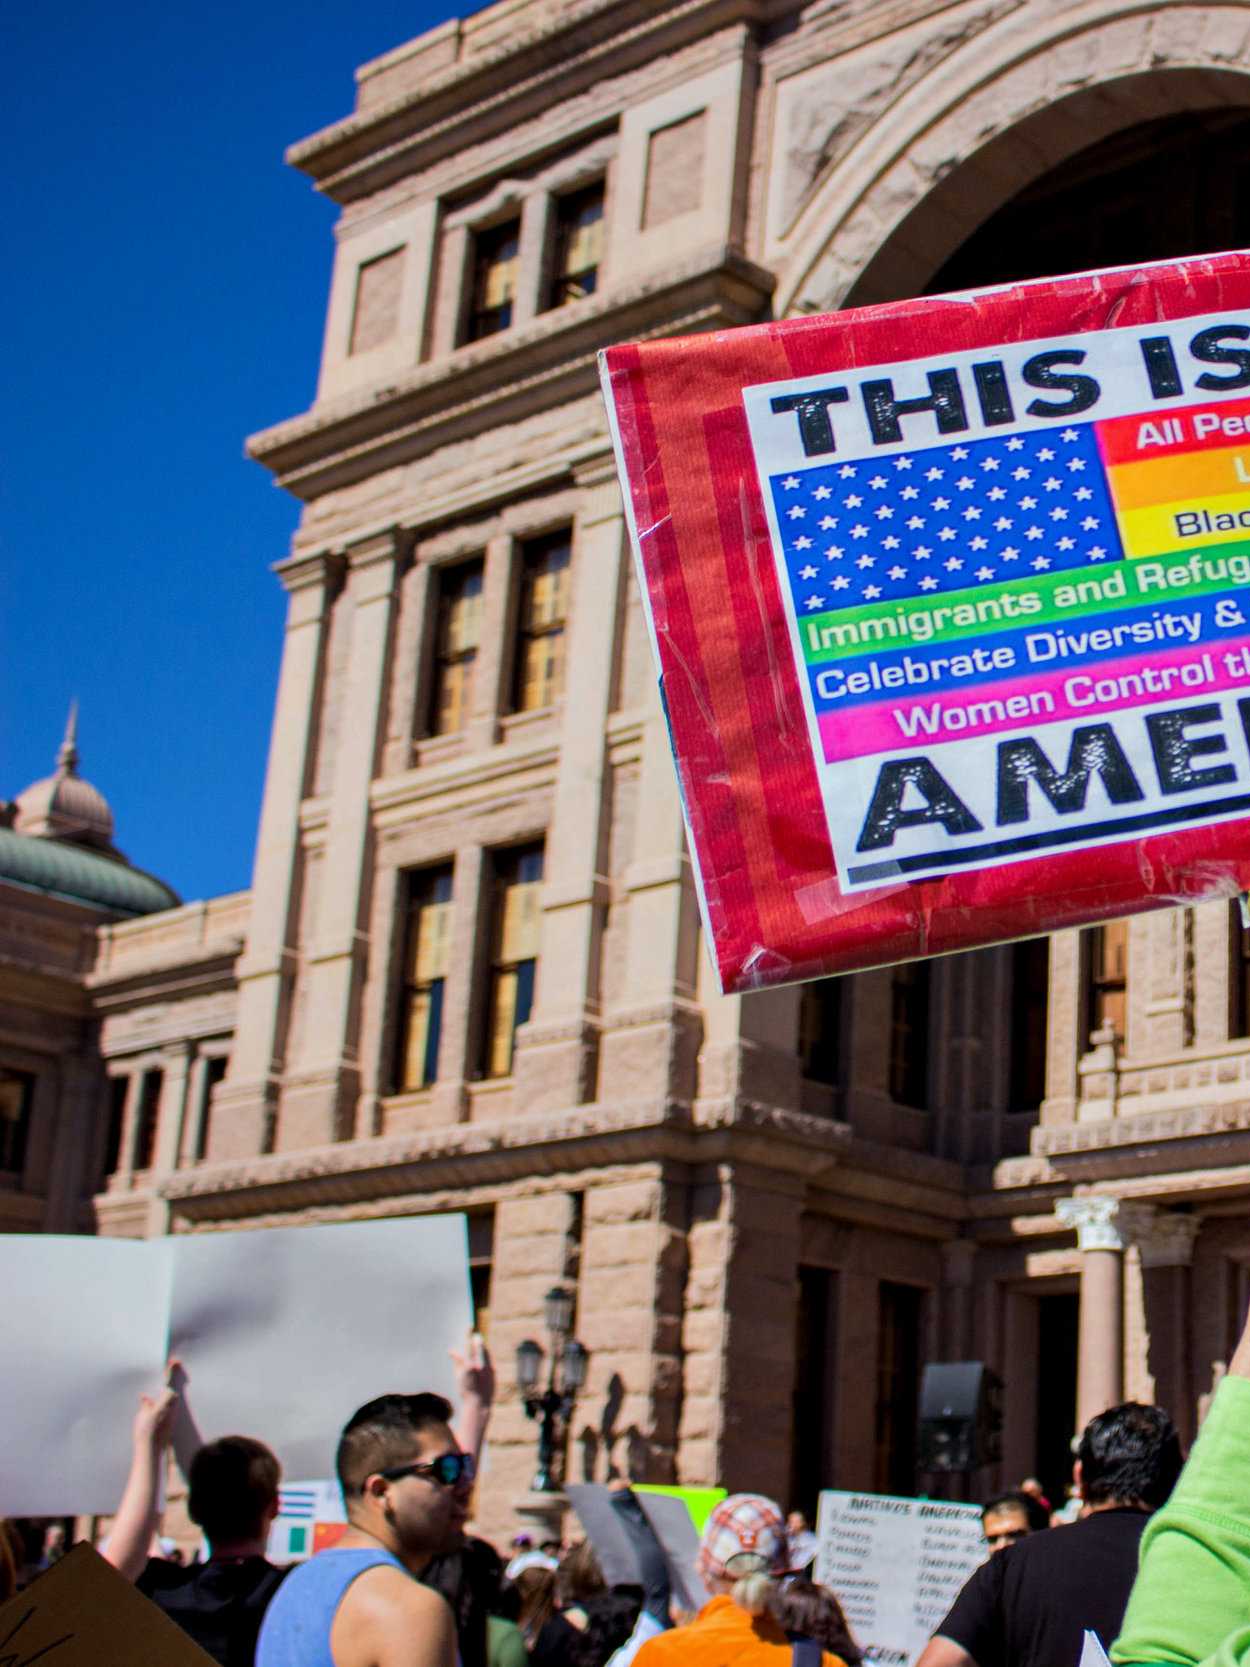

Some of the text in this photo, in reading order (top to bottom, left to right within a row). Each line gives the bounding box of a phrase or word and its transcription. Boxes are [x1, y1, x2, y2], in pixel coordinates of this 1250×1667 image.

[771, 348, 1101, 457] THIS
[1136, 419, 1182, 450] All
[807, 588, 1043, 652] Immigrants
[1054, 568, 1126, 608] and
[816, 642, 1016, 700] Celebrate
[1025, 610, 1202, 664] Diversity
[1214, 599, 1246, 629] &
[893, 690, 1055, 739] Women
[1064, 655, 1216, 708] Control
